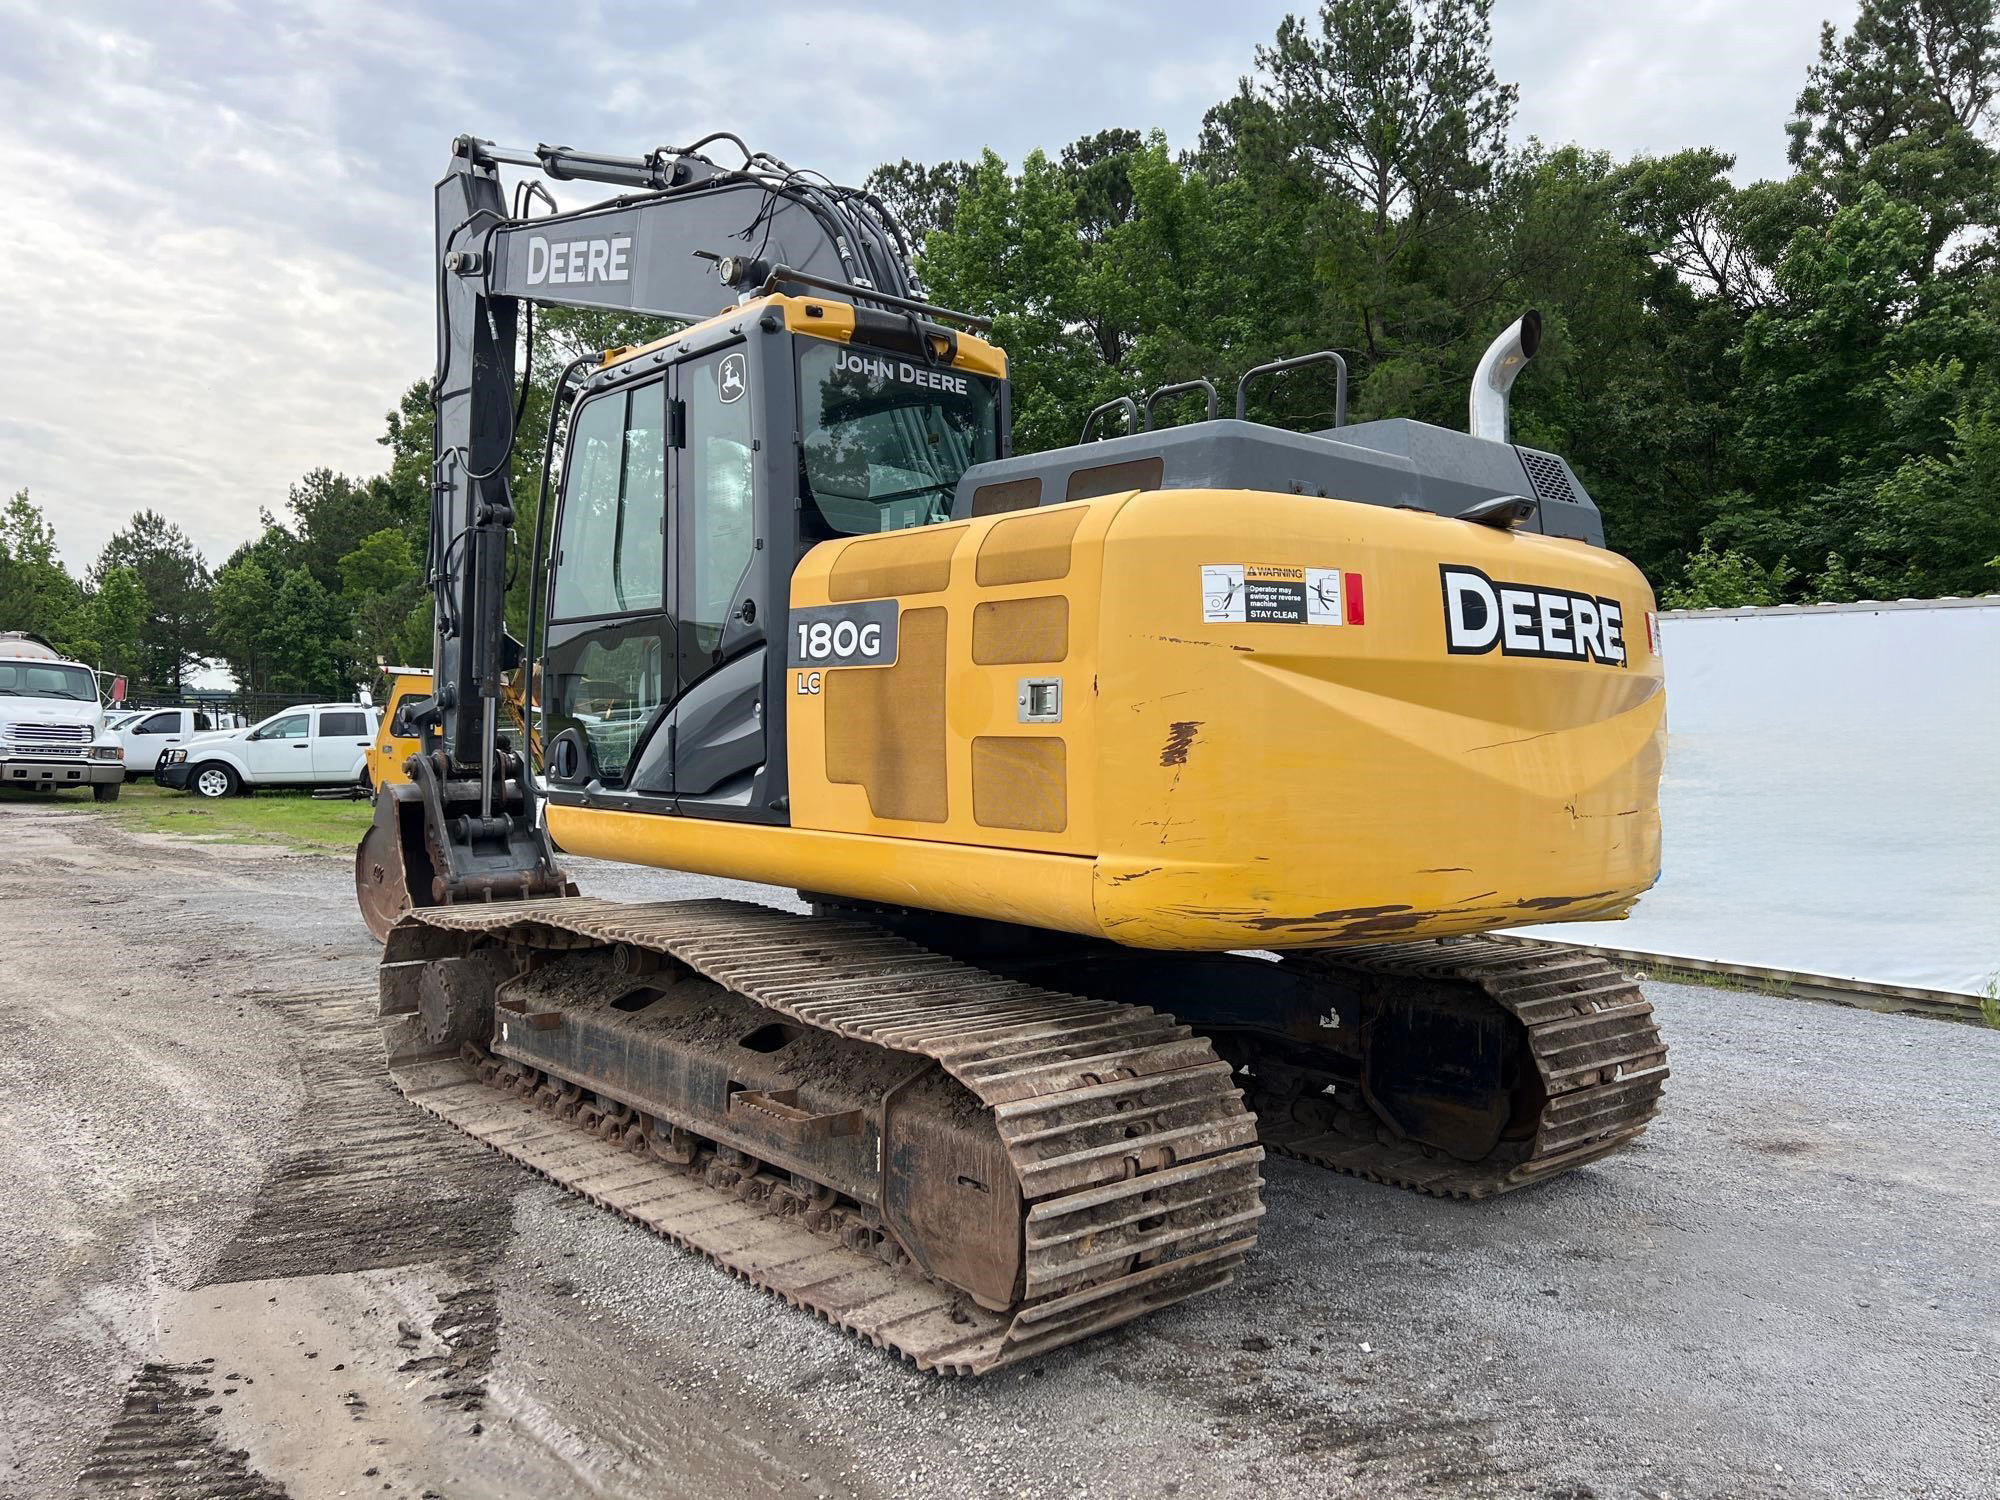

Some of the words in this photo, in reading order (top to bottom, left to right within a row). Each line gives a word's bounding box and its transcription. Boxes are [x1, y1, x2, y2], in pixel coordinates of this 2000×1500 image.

[527, 236, 632, 285] DEERE
[835, 350, 894, 380] JOHN
[899, 362, 968, 395] DEERE
[1257, 566, 1303, 578] WARNING
[1250, 585, 1277, 593] Operator
[1250, 593, 1269, 601] swing
[1250, 610, 1271, 618] STAY
[1272, 610, 1298, 619] CLEAR
[1445, 571, 1625, 661] DEERE
[798, 620, 881, 658] 180G
[797, 673, 821, 694] LC
